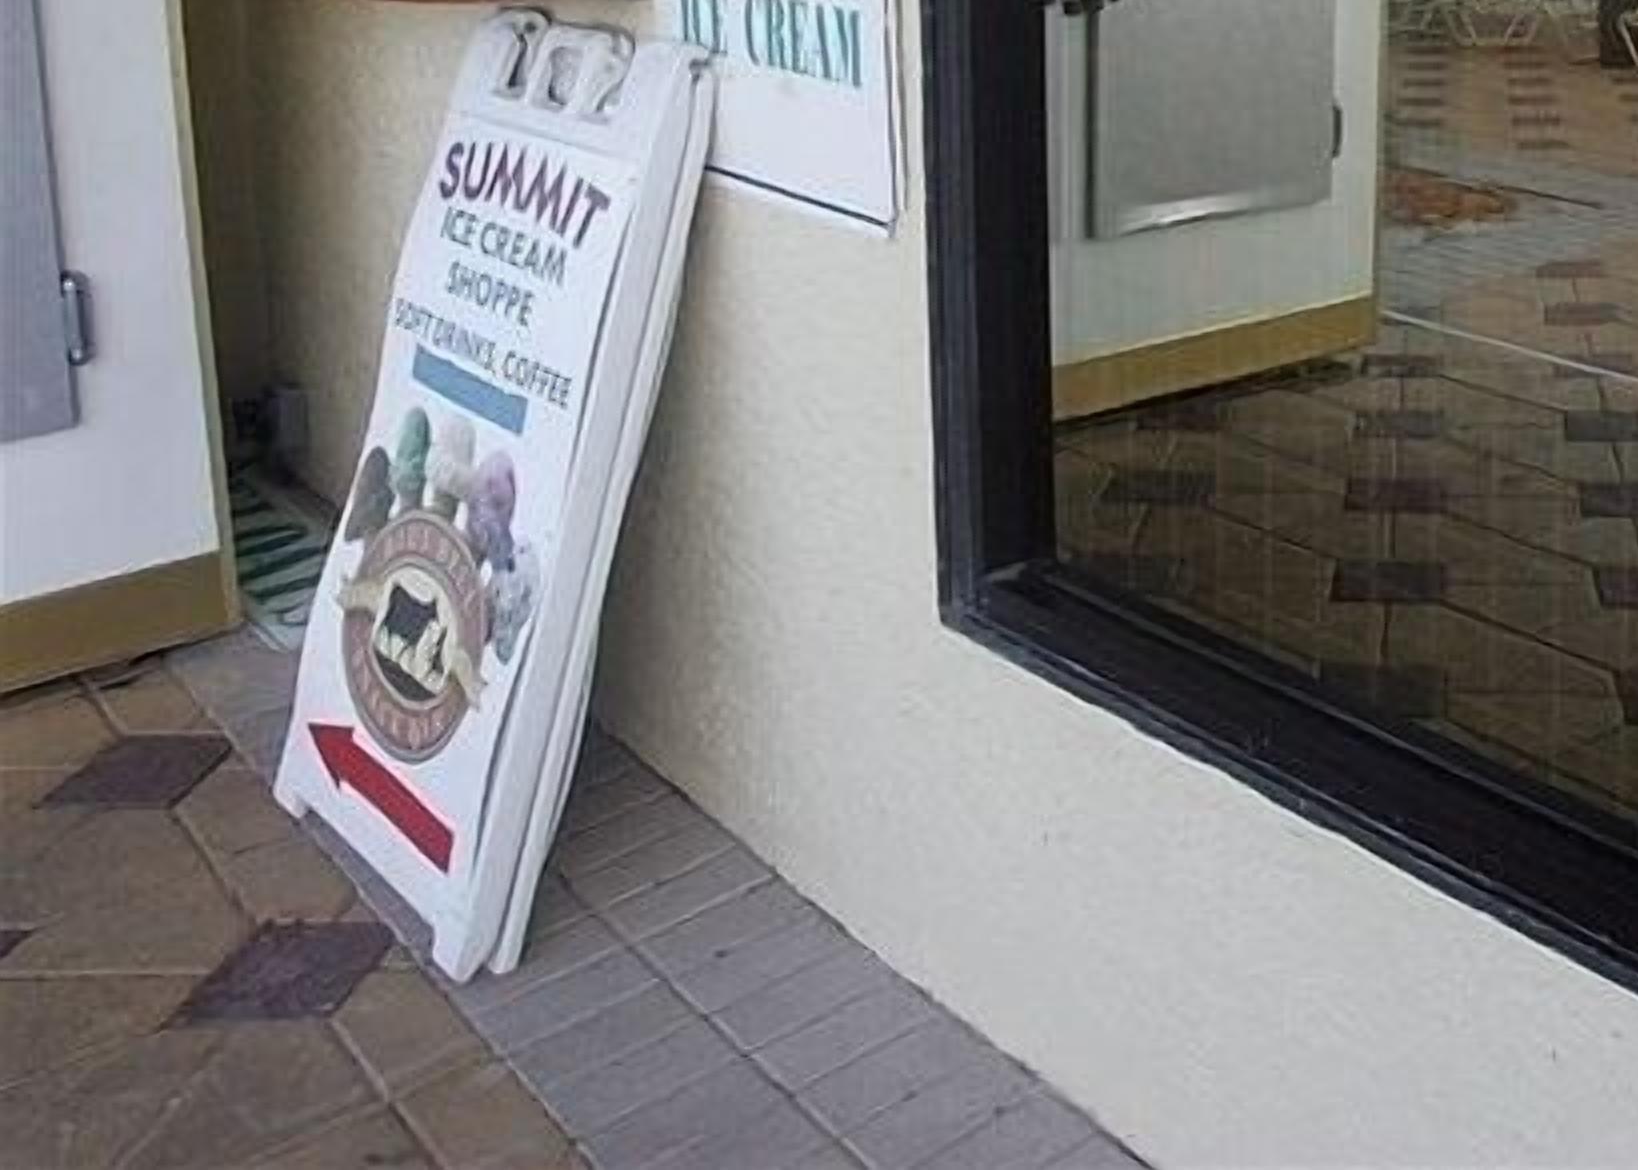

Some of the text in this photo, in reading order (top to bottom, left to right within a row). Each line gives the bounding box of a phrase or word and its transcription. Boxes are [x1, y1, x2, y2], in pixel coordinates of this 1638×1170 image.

[439, 142, 611, 248] SUMMIT
[441, 207, 567, 286] ICE CREAM
[447, 261, 535, 327] SHOPPE
[502, 350, 573, 409] COFFEE
